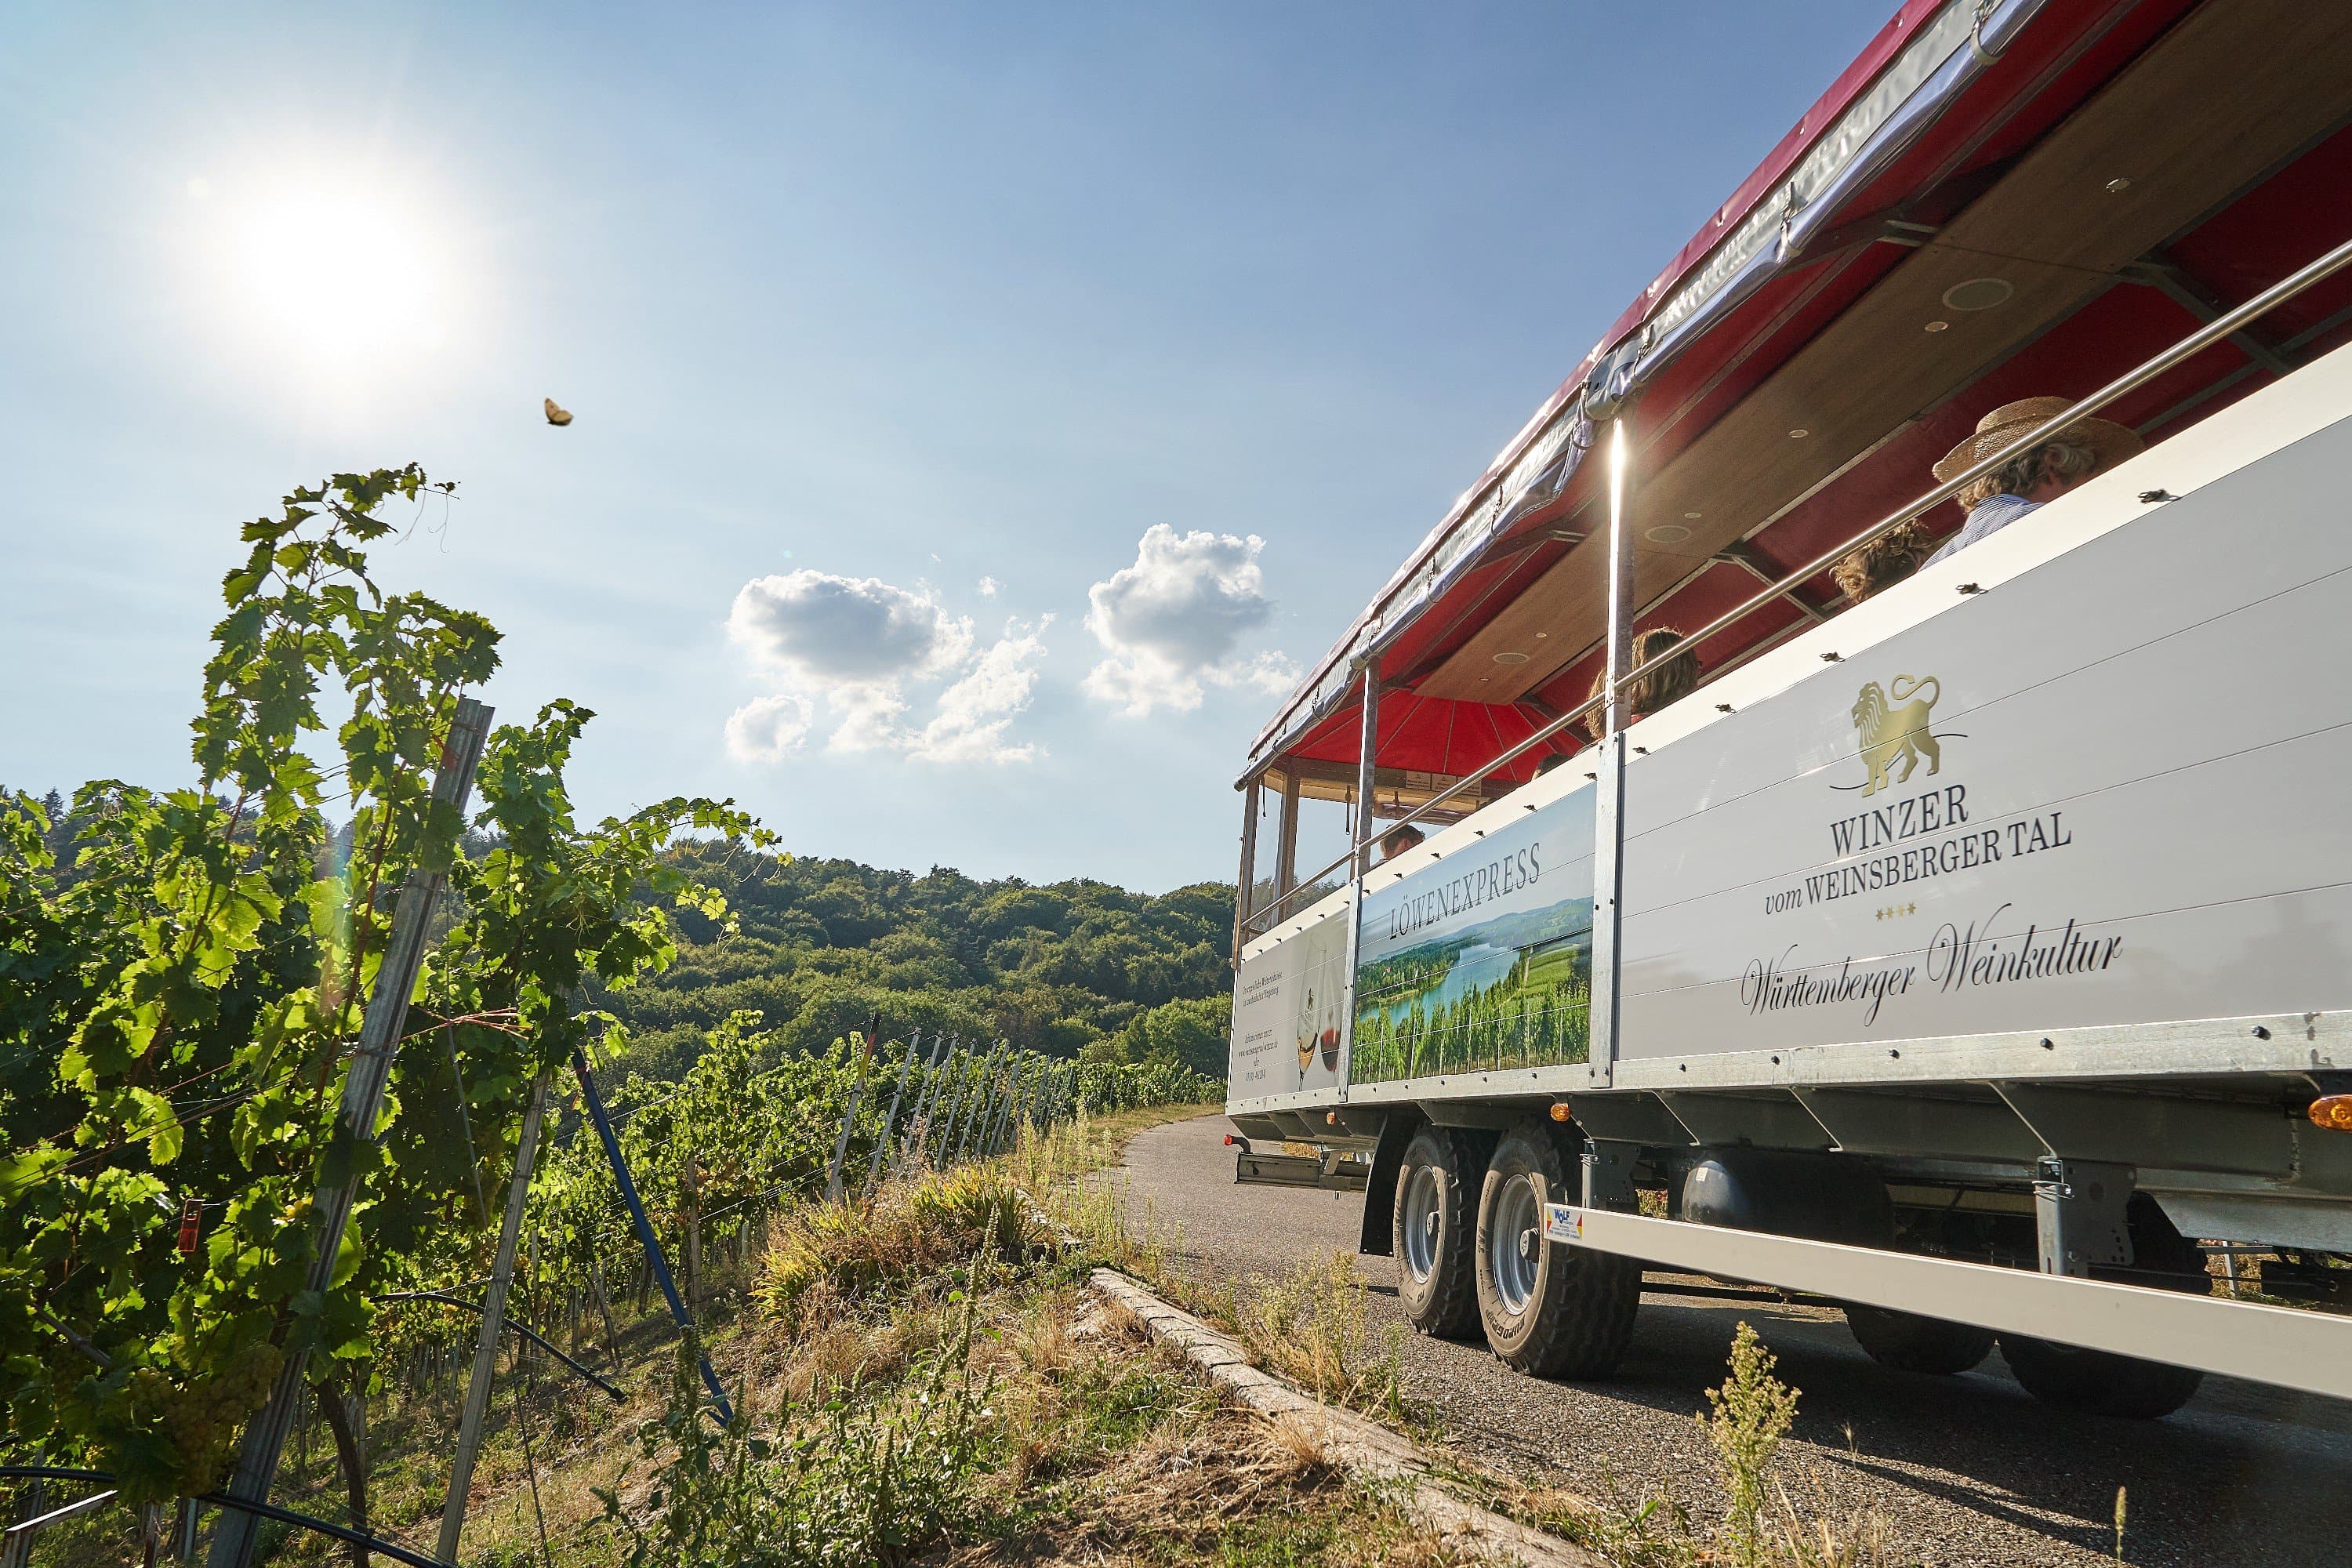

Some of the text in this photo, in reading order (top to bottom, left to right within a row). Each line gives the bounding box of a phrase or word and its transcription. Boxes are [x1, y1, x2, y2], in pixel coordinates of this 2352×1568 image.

[1830, 784, 1969, 857] WINZER
[1390, 842, 1541, 941] LÖWENEXPRESS
[1765, 887, 1803, 915] vom
[1741, 902, 2124, 1027] Württemberger Weinkultur
[1554, 1208, 1570, 1225] WOLF
